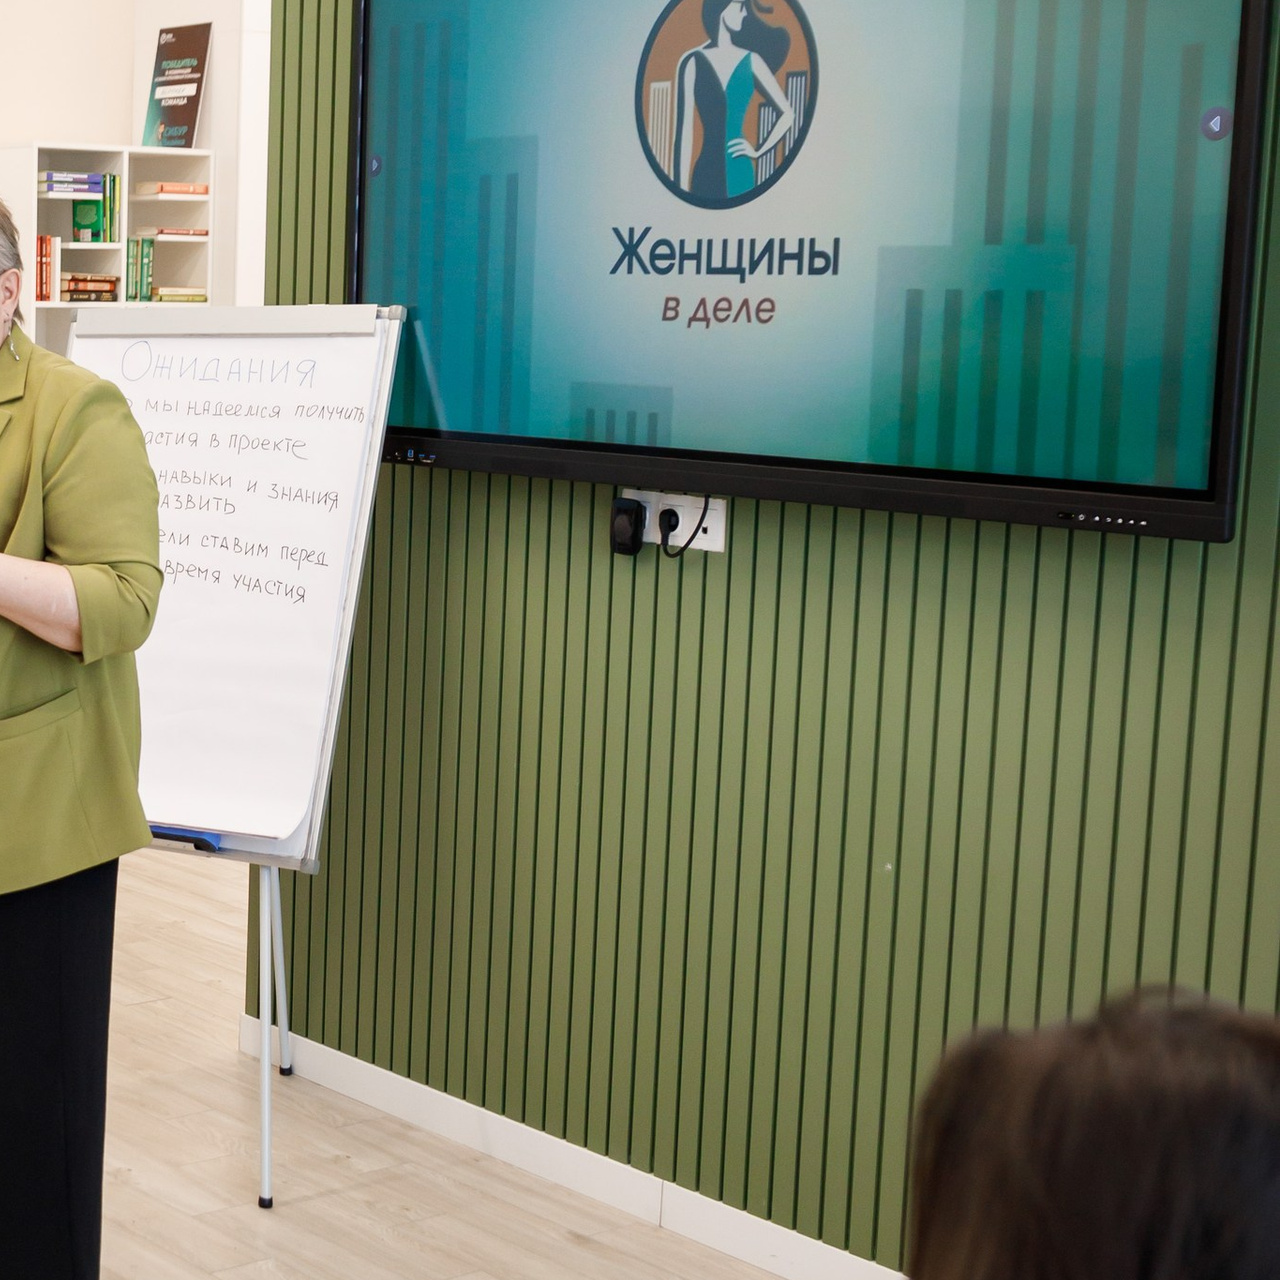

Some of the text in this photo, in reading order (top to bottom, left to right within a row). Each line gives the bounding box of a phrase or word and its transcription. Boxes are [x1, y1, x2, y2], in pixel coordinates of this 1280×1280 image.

[609, 226, 840, 284] Женщины
[662, 296, 776, 329] в деле
[144, 430, 199, 448] астия
[228, 433, 309, 461] проекте
[159, 528, 191, 547] ели
